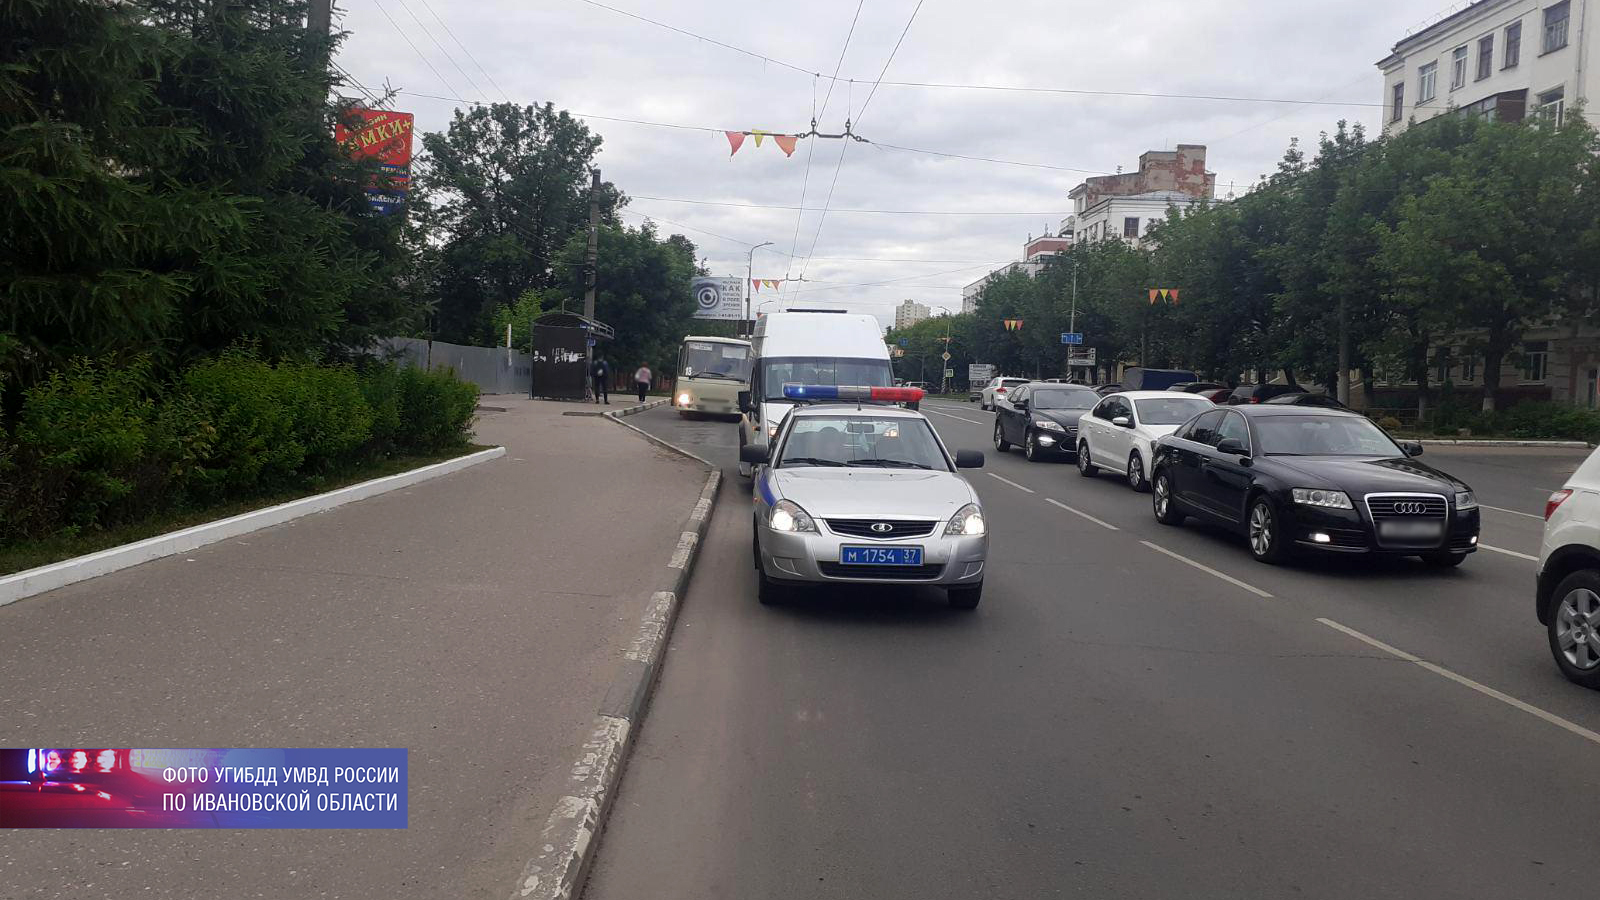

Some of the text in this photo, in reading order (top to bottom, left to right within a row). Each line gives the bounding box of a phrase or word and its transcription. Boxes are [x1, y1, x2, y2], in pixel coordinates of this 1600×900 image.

[848, 549, 916, 563] М 1754 37
